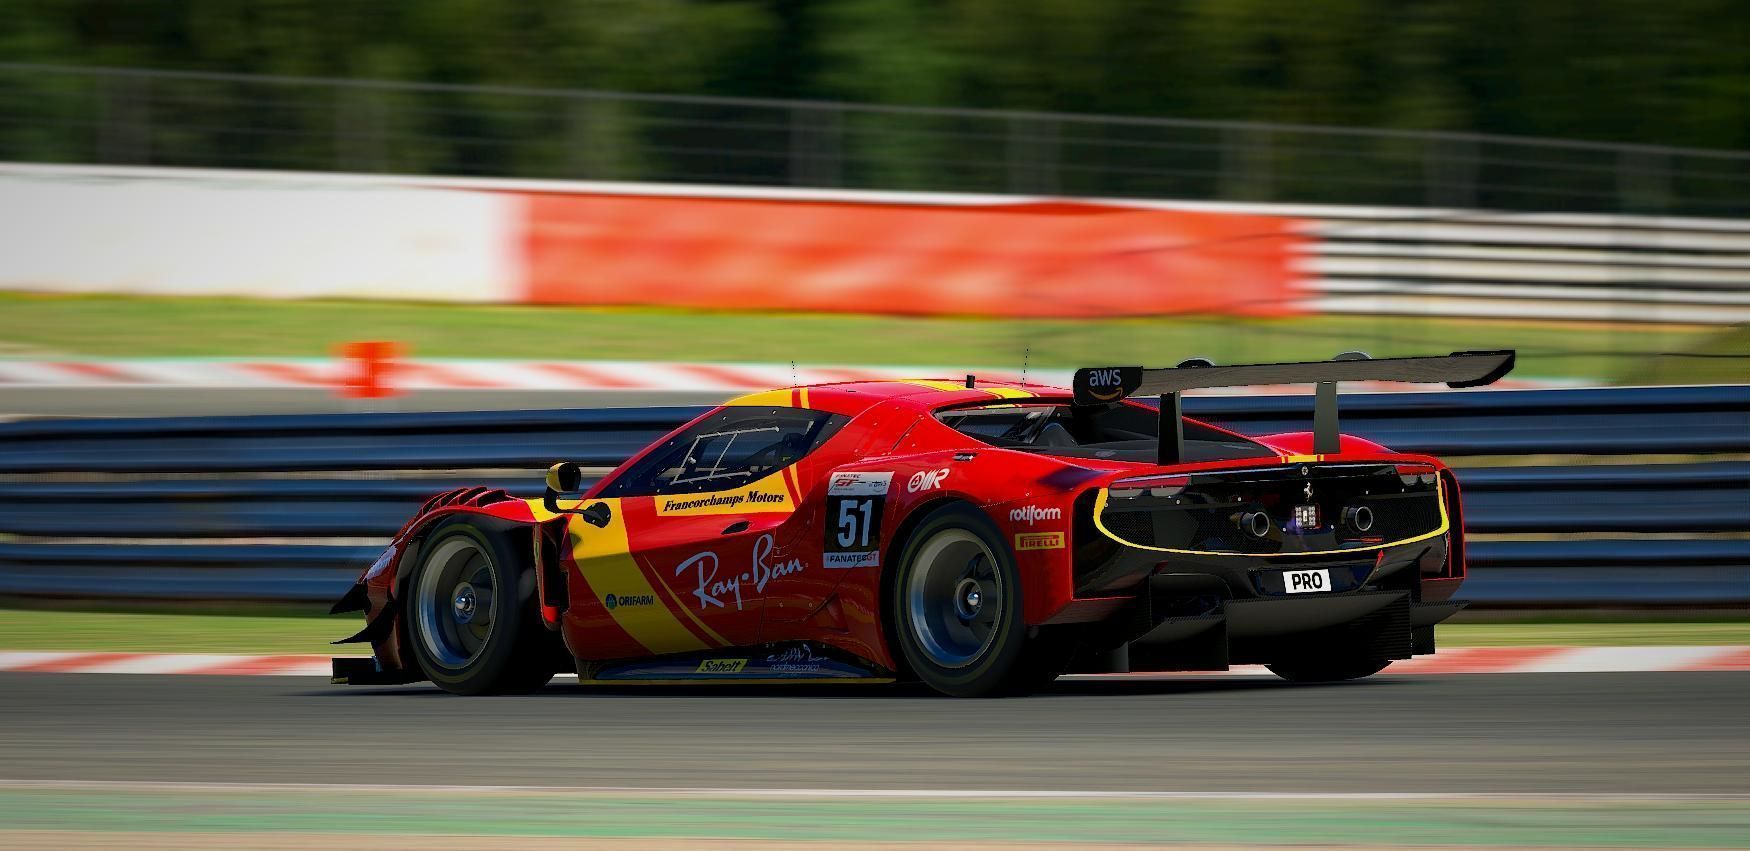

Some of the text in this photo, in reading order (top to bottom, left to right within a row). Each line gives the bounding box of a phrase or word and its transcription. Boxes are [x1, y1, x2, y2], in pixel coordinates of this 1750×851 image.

[1089, 369, 1122, 387] aws
[663, 491, 785, 512] Francorchamps Motors
[837, 499, 873, 548] 51
[1009, 504, 1062, 526] rotiform
[1019, 534, 1060, 548] PIRELLI
[1291, 572, 1323, 590] PRO
[618, 595, 654, 606] ORIFARM
[702, 660, 741, 672] Sabelt
